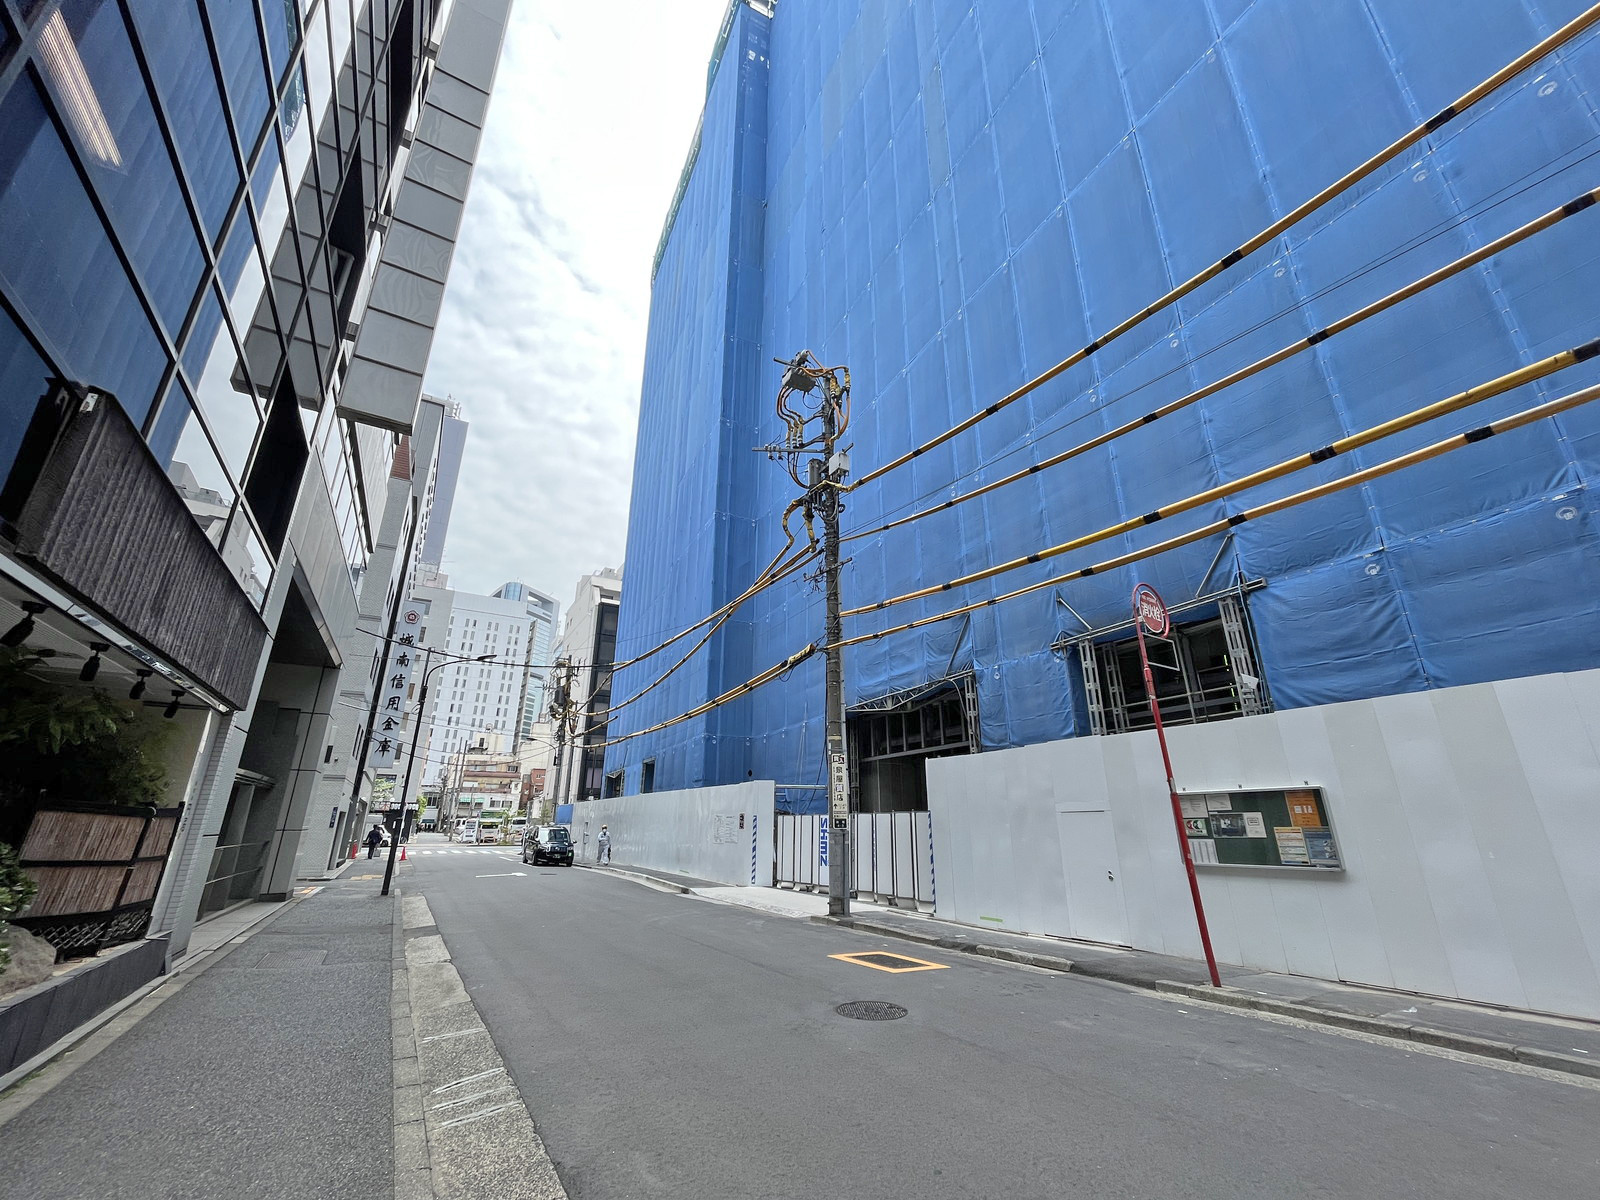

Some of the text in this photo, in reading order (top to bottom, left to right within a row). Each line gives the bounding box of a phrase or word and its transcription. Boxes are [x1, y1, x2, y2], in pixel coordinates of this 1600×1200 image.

[1141, 601, 1162, 622] 消火栓
[375, 633, 414, 757] 城南信用金庫
